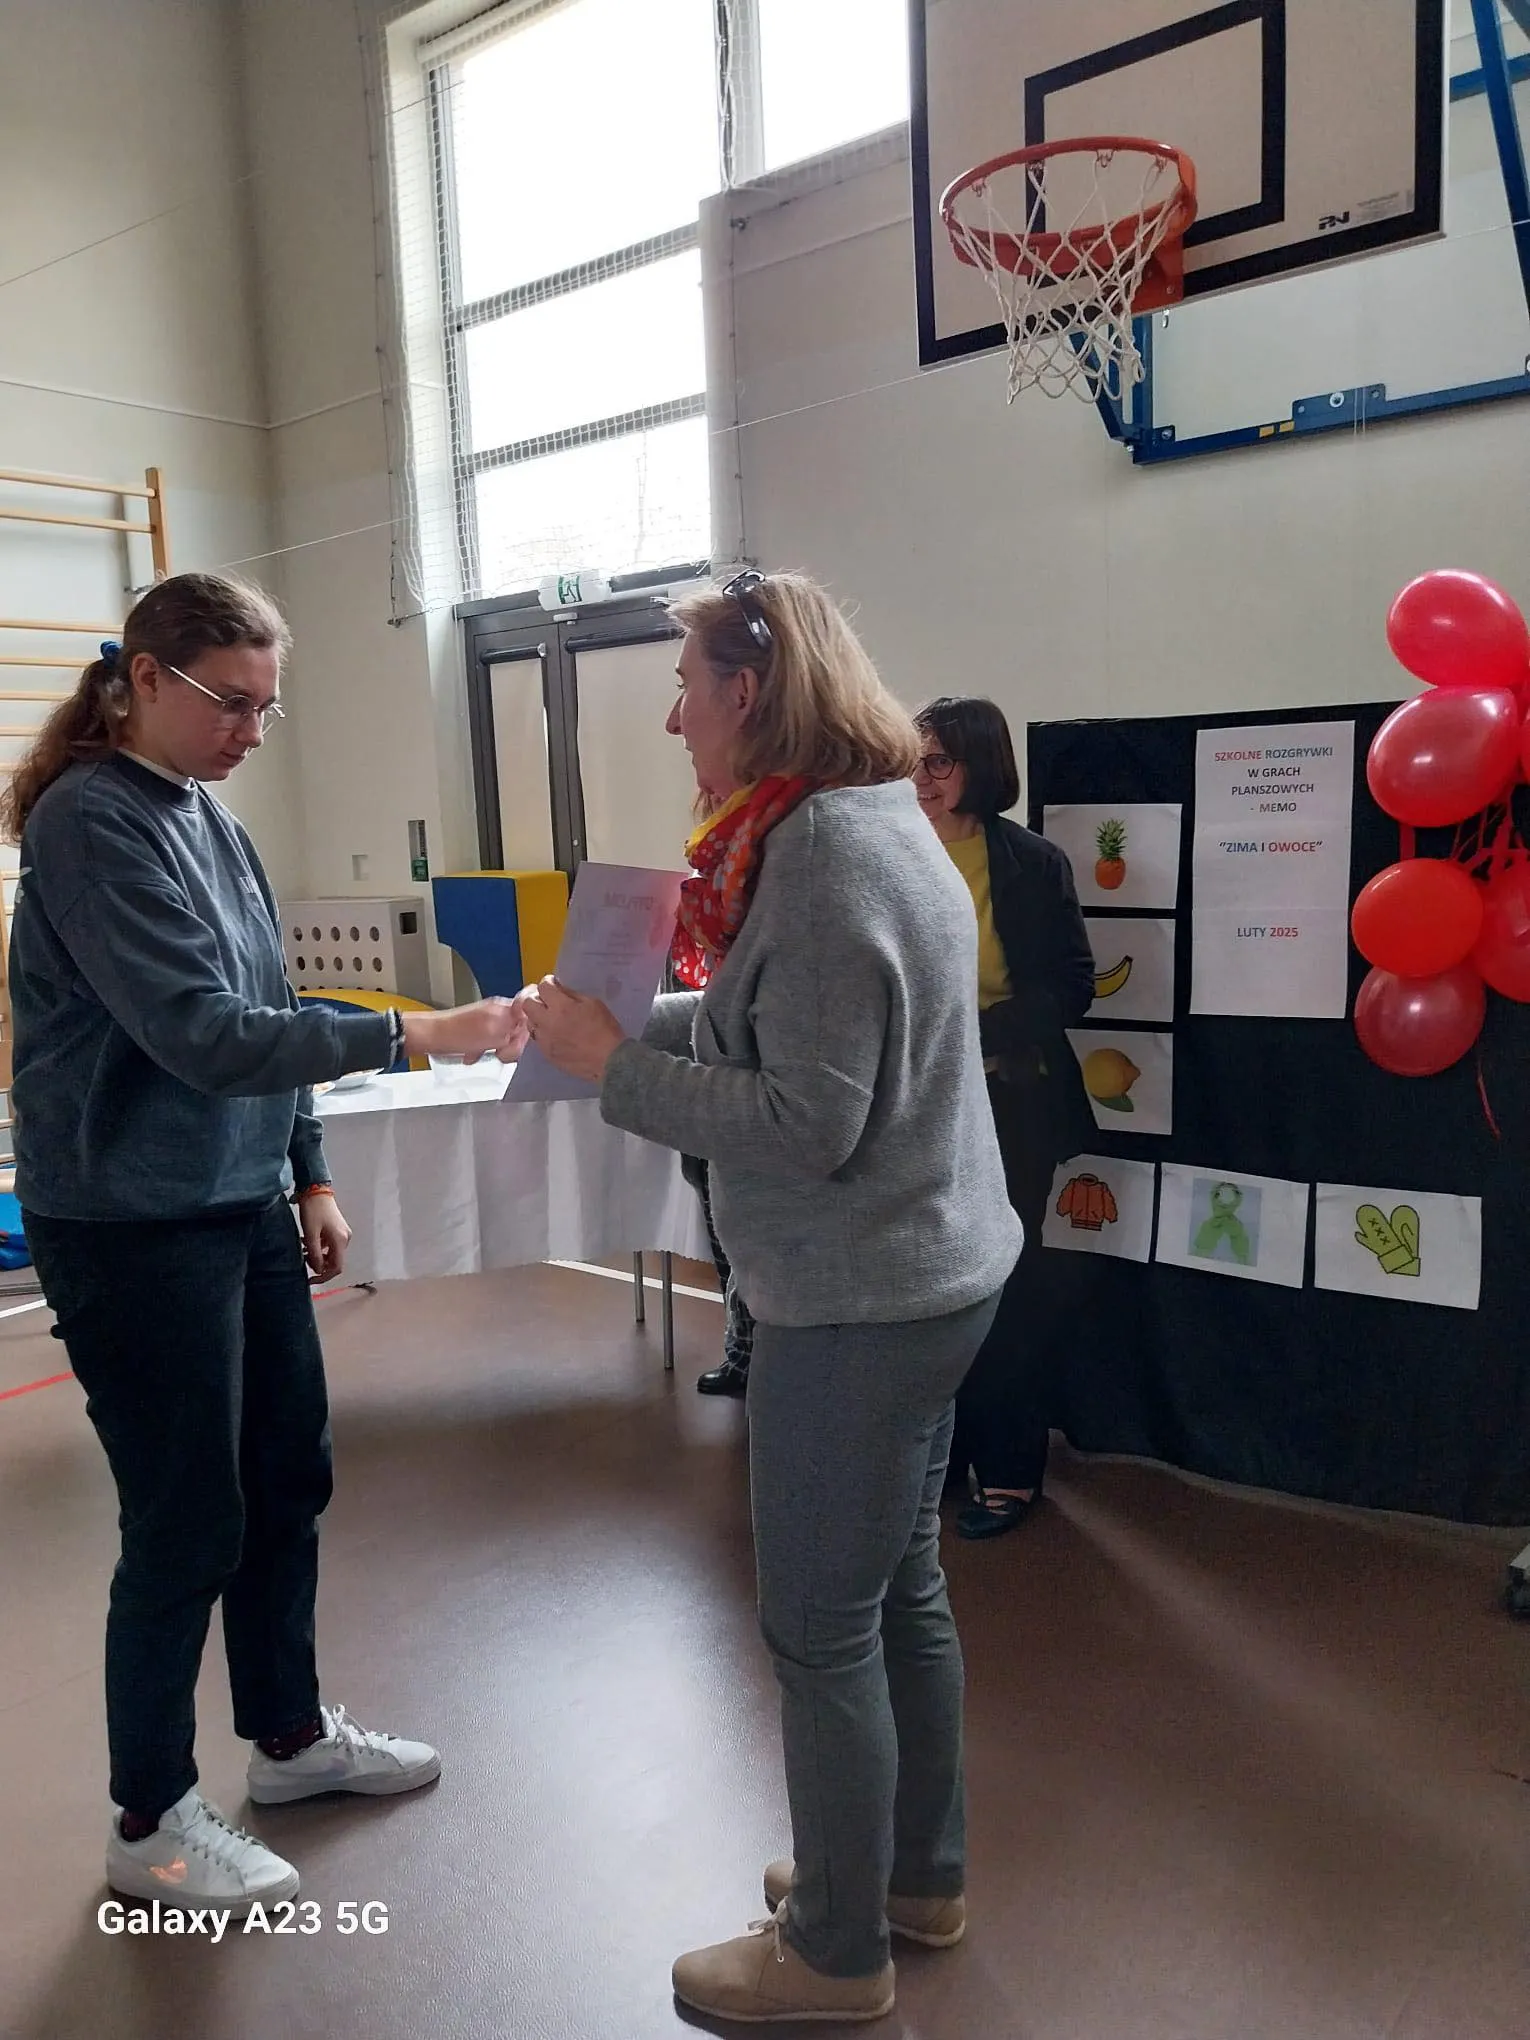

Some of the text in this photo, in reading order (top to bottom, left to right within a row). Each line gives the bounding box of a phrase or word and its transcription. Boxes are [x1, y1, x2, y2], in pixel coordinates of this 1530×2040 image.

[1214, 747, 1333, 762] SZKOLNE ROZGRYWKI
[1247, 766, 1301, 778] W GRACH
[1231, 783, 1314, 796] PLANSZOWYCH
[1259, 802, 1297, 813] MEMO
[1261, 842, 1265, 852] I
[1237, 927, 1298, 938] LUTY 2025
